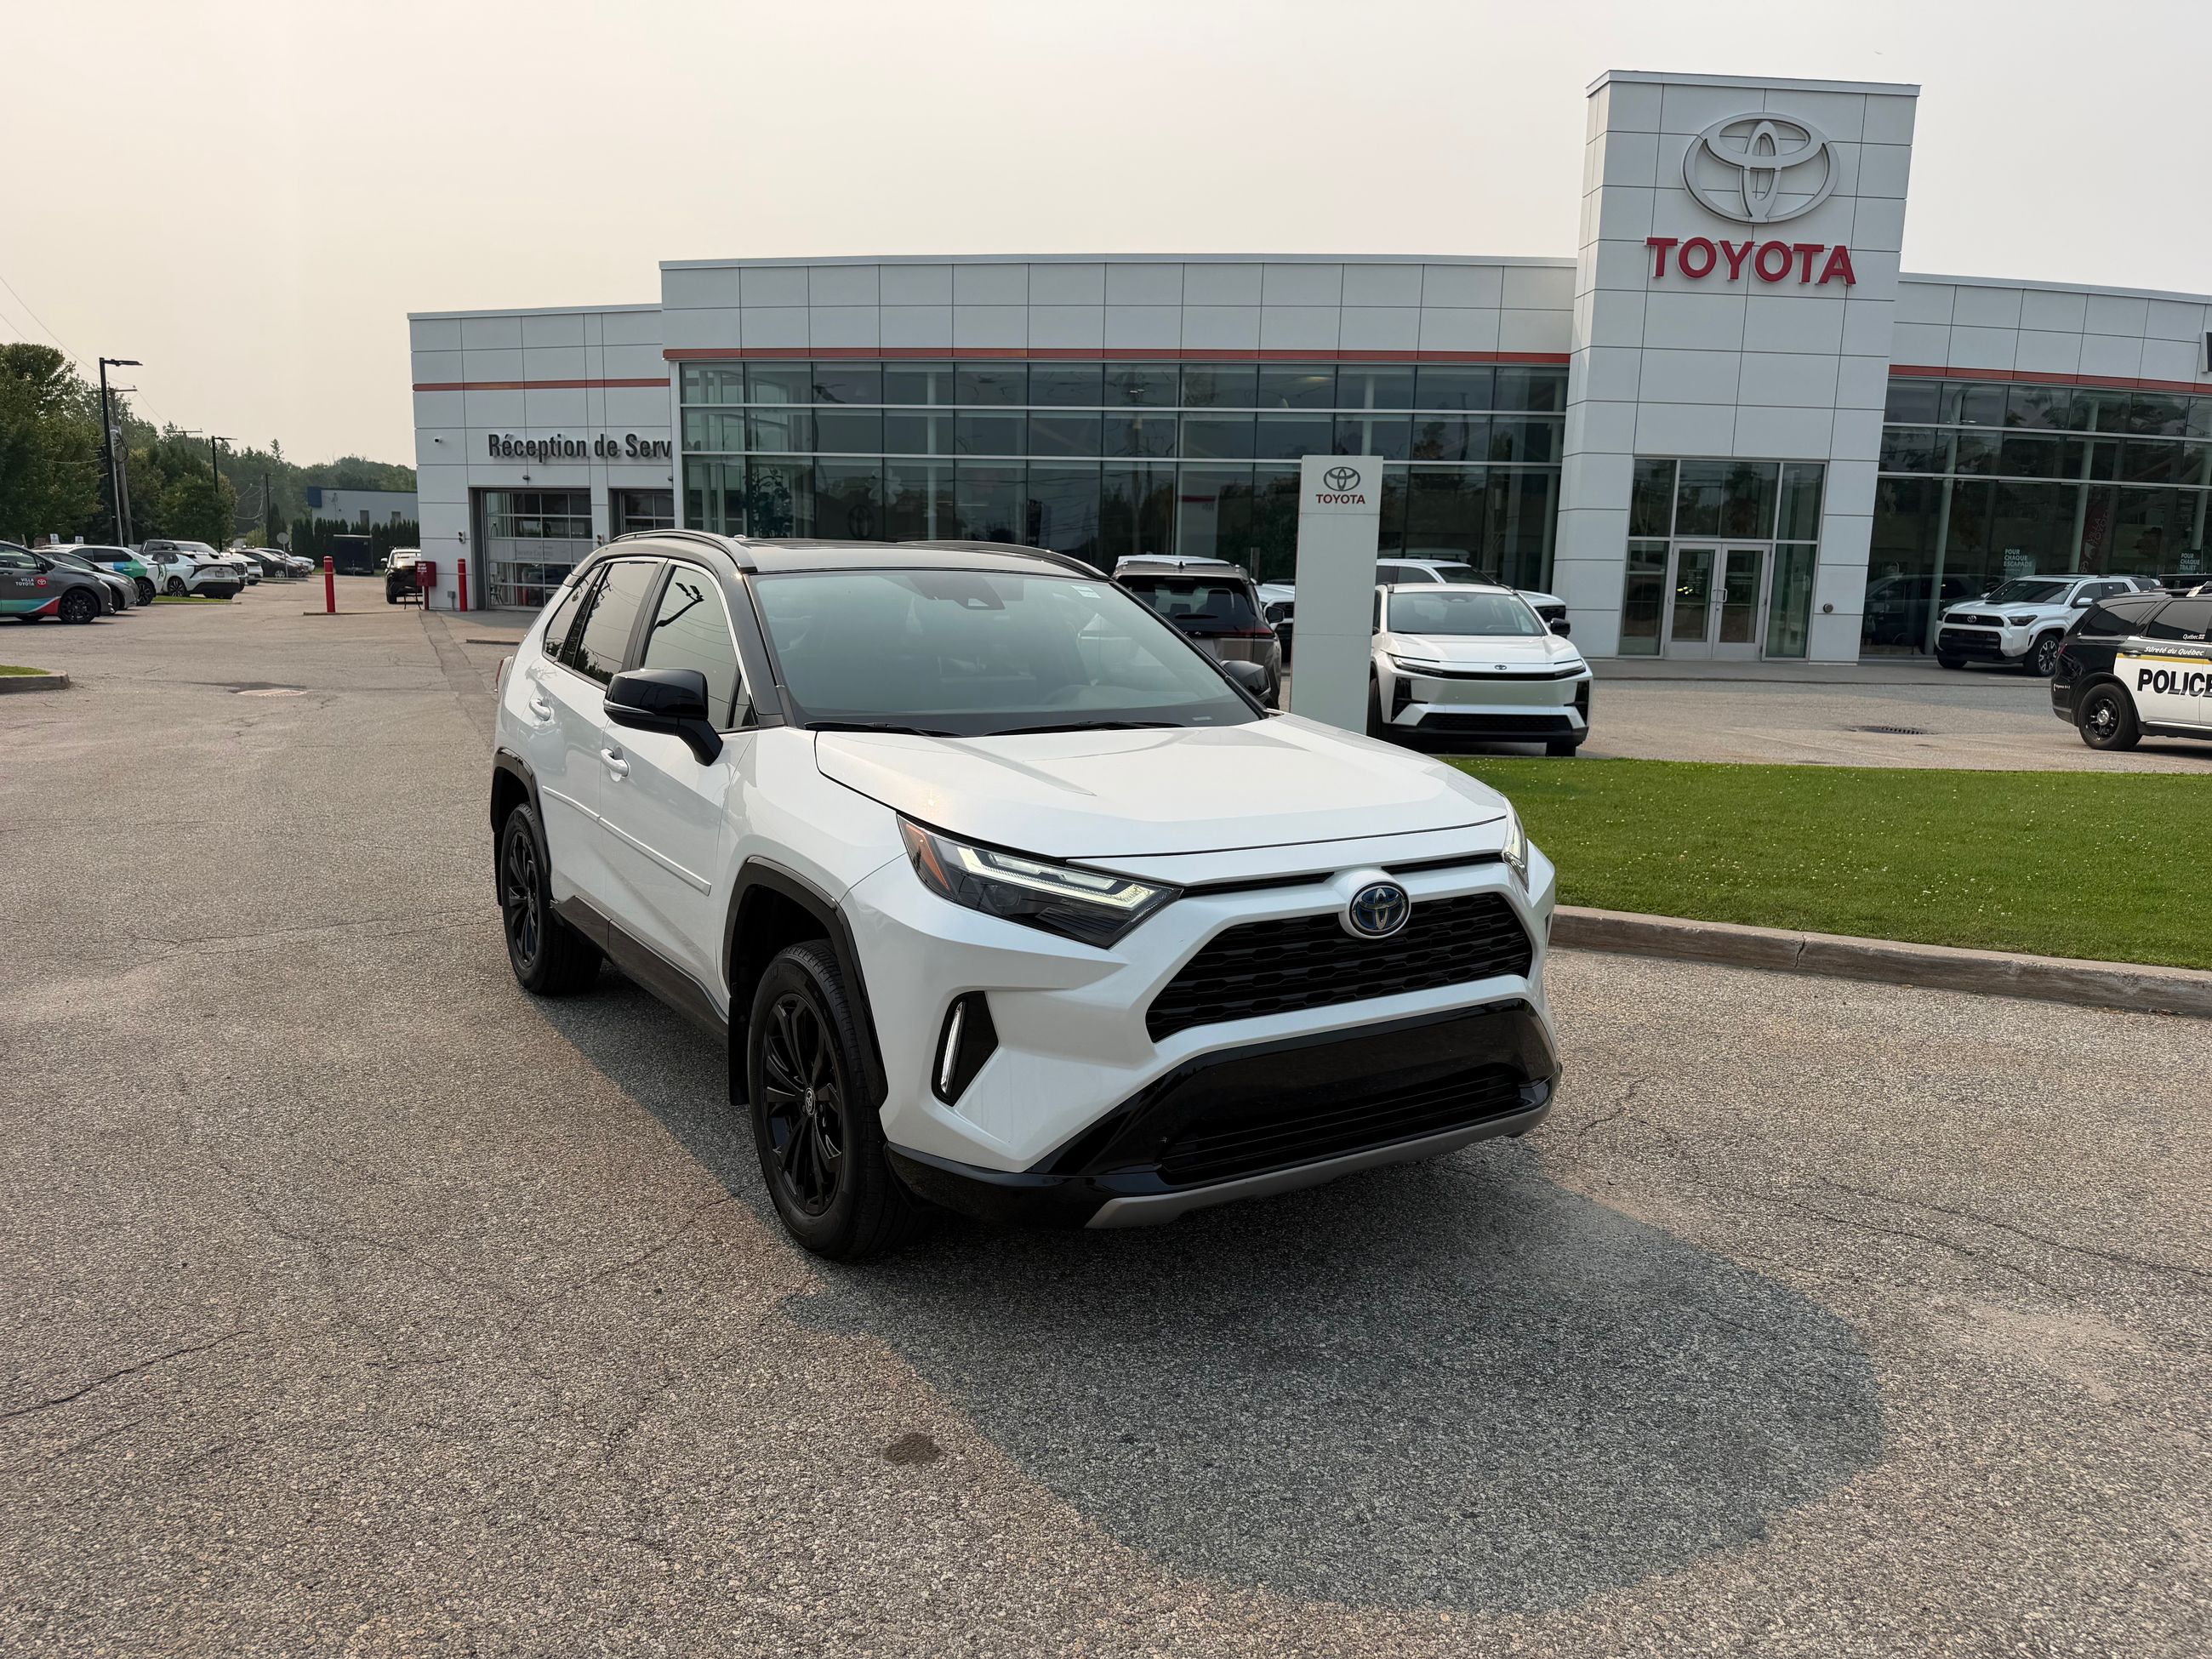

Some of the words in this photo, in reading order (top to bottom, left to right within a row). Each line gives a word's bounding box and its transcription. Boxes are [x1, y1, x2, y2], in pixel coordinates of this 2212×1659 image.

[1645, 237, 1856, 285] TOYOTA
[488, 434, 587, 463] Réception
[594, 434, 618, 457] de
[1315, 494, 1365, 504] TOYOTA
